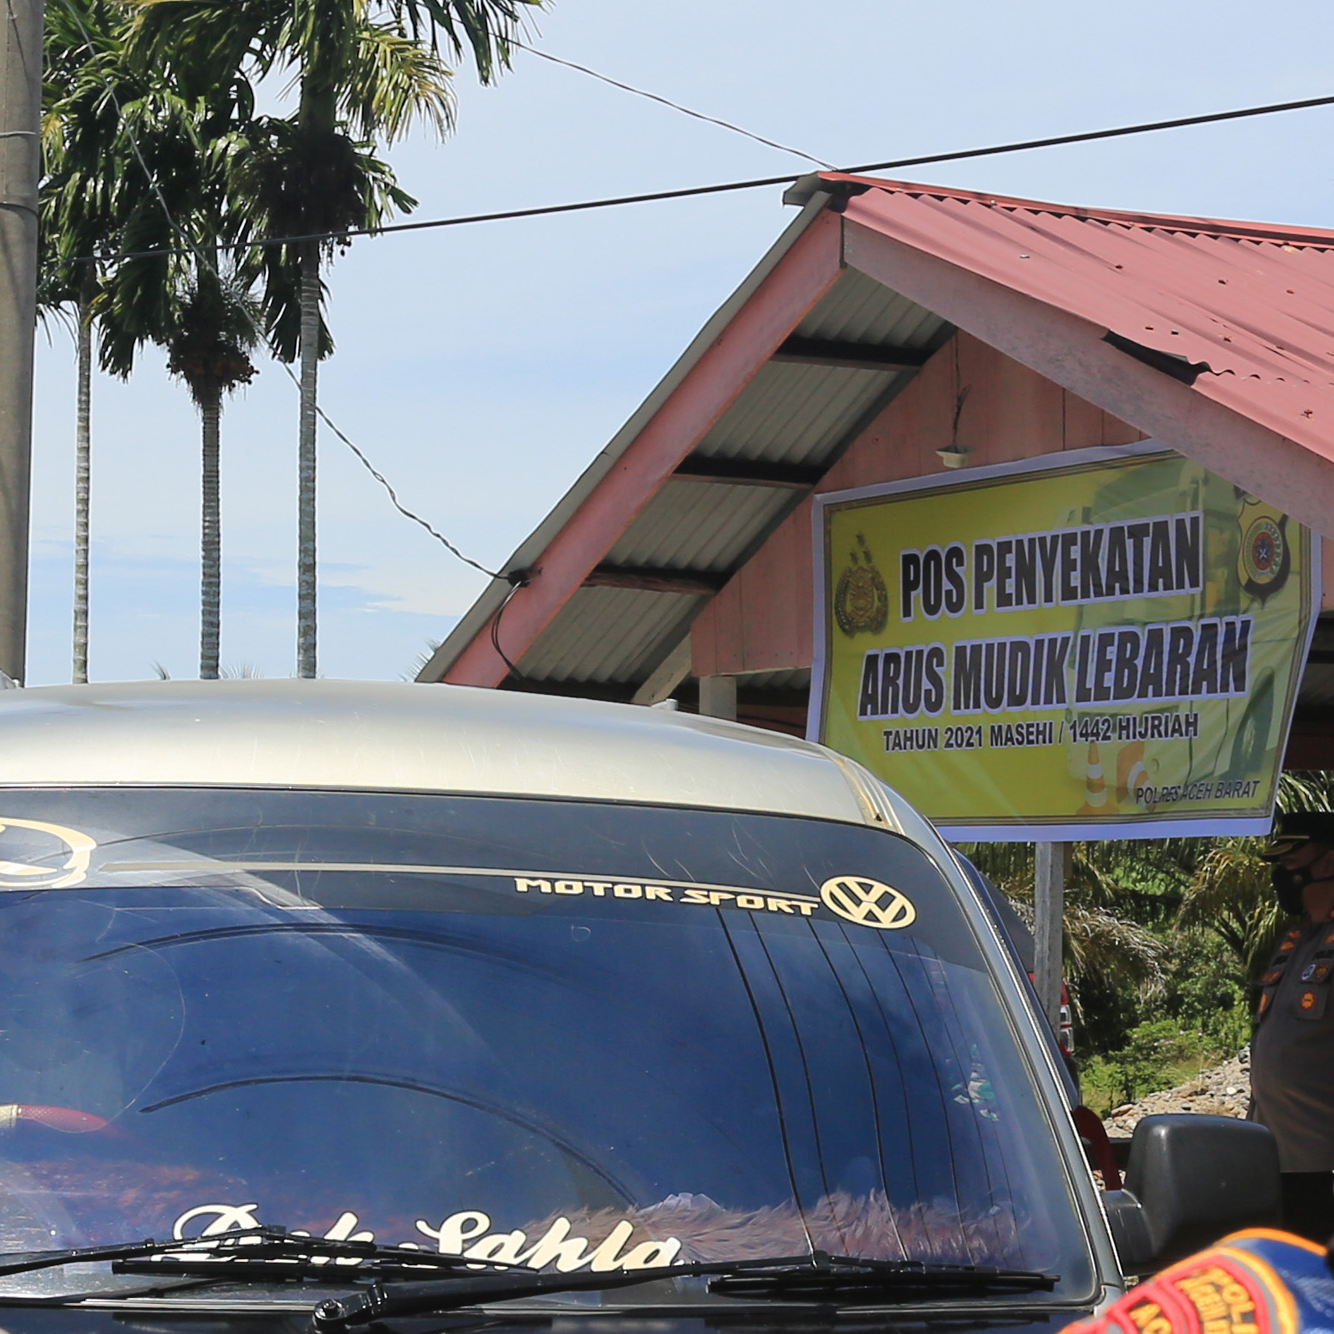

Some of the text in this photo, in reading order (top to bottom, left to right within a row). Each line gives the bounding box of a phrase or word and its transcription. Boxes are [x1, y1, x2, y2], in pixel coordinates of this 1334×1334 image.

[901, 515, 1201, 619] POS PENYEKATAN
[860, 619, 1252, 718] ARUS MUDIK LEBARAN
[883, 727, 938, 751] TAHUN
[944, 725, 983, 749] 2021
[990, 721, 1053, 747] MASEHI
[1069, 718, 1112, 743] 1442
[1118, 712, 1199, 740] HIJRIAH
[1135, 780, 1261, 805] POLRES ACEH BARAT
[514, 878, 672, 902] MOTOR
[679, 888, 819, 916] SPORT
